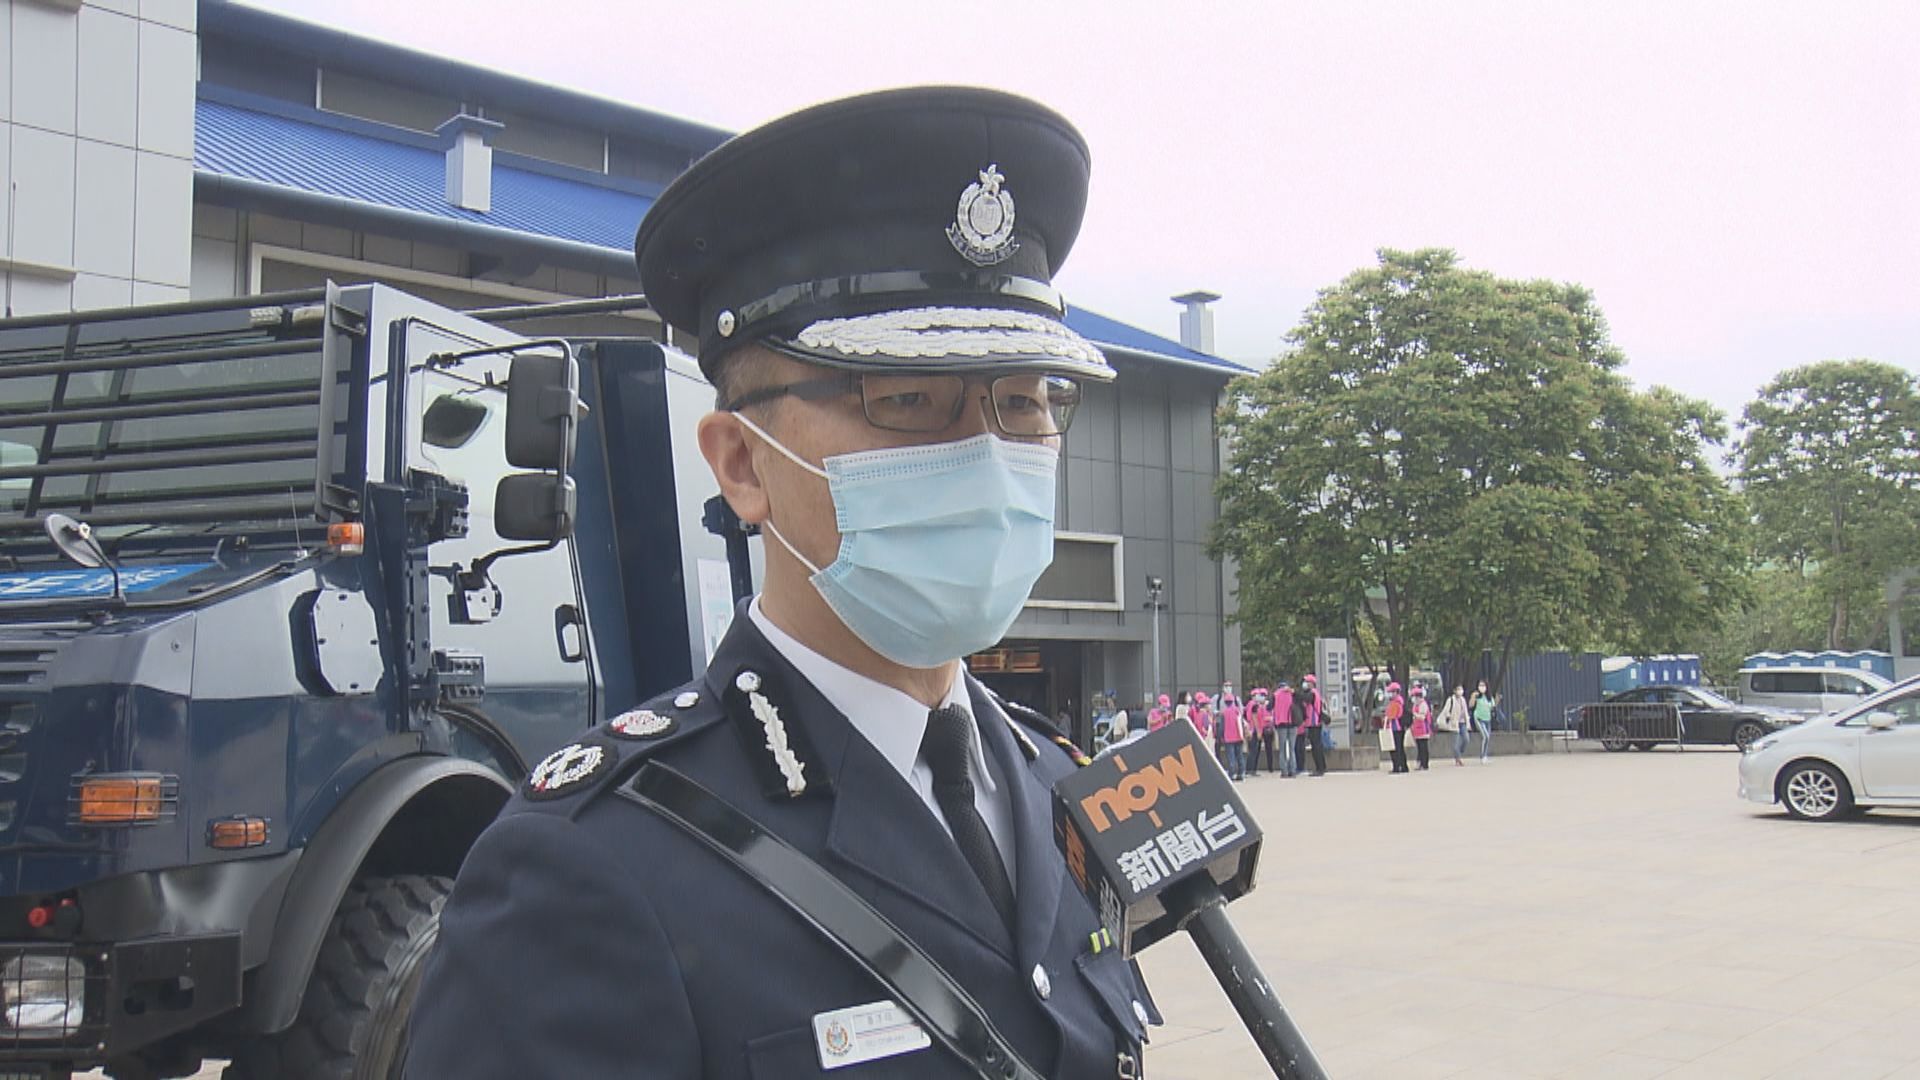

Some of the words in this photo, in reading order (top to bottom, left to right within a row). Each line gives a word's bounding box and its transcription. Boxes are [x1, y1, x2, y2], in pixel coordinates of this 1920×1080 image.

[1080, 744, 1201, 833] now
[1116, 803, 1247, 894] 新聞台
